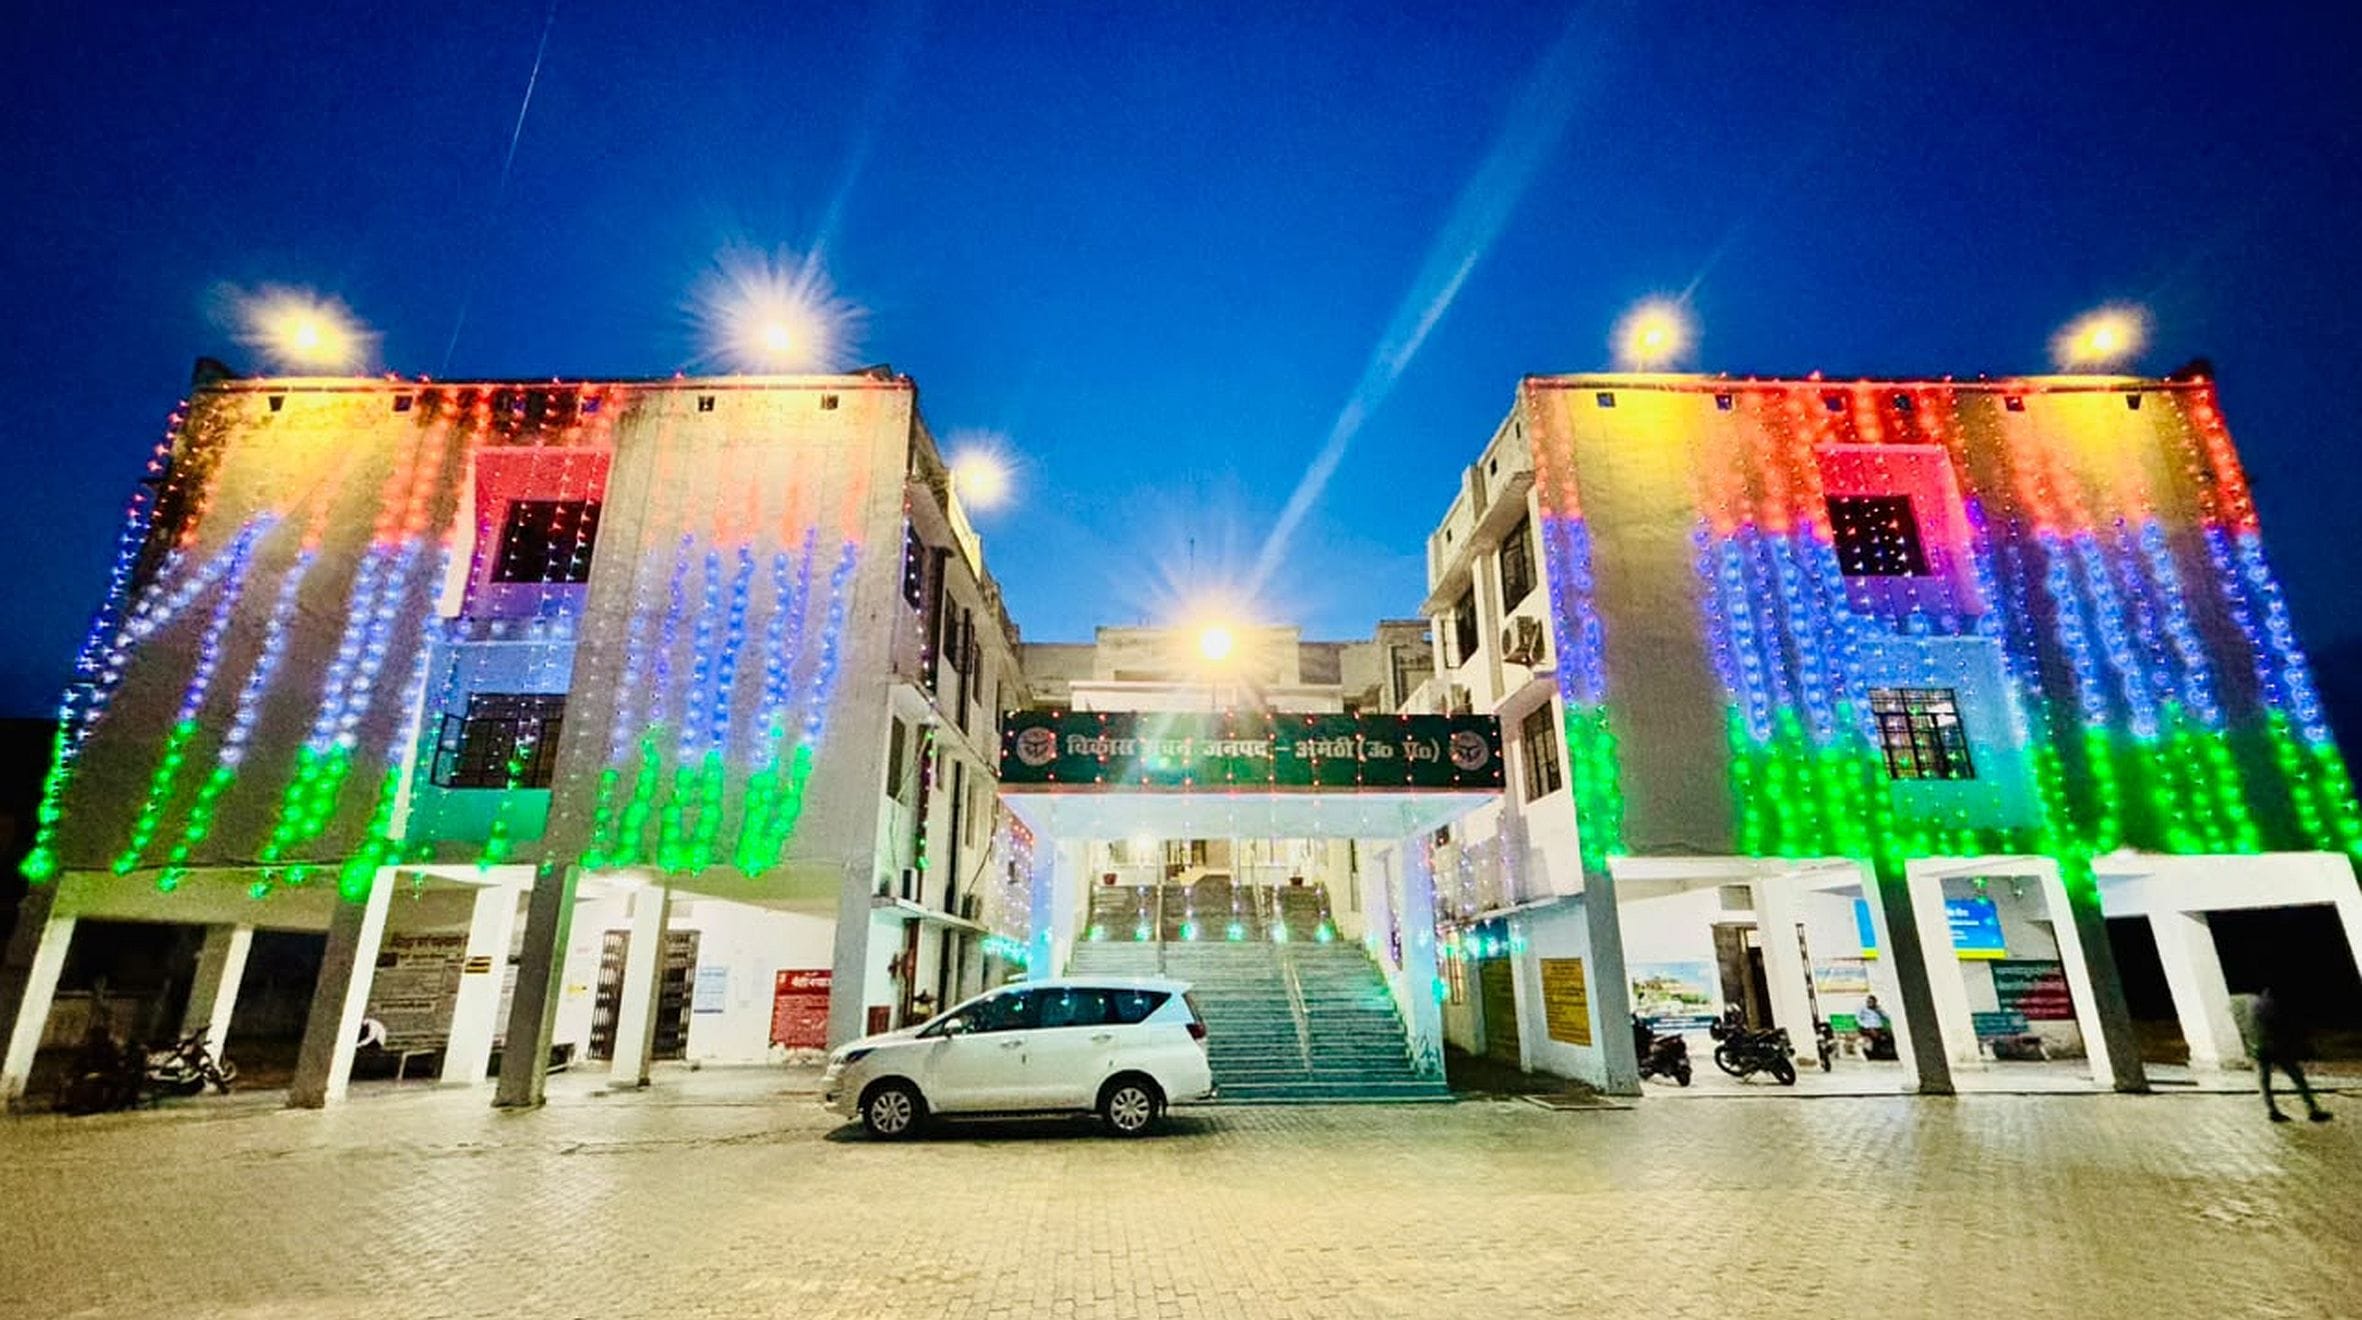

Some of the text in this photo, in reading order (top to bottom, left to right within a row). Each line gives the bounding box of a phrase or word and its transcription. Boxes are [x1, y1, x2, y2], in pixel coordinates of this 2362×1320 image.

[1067, 734, 1135, 757] विकास
[1141, 738, 1192, 756] वन
[1203, 739, 1272, 757] जनपद
